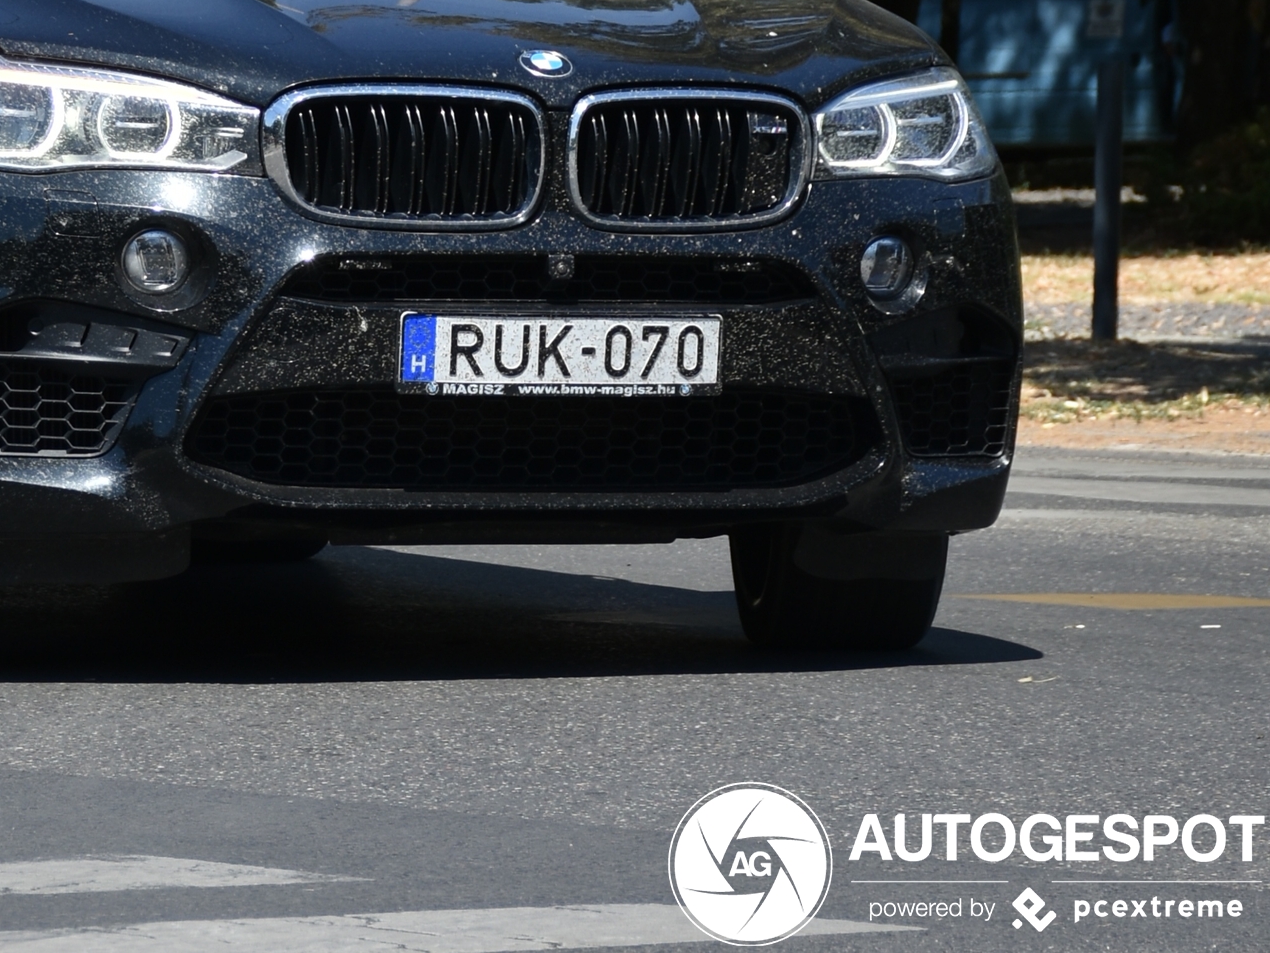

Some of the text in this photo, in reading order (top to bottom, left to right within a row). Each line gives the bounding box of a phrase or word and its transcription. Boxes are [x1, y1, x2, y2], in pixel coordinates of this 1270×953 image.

[410, 324, 705, 380] H RUK-070
[443, 383, 676, 396] MAGISZ www.bmw-magisz.hu
